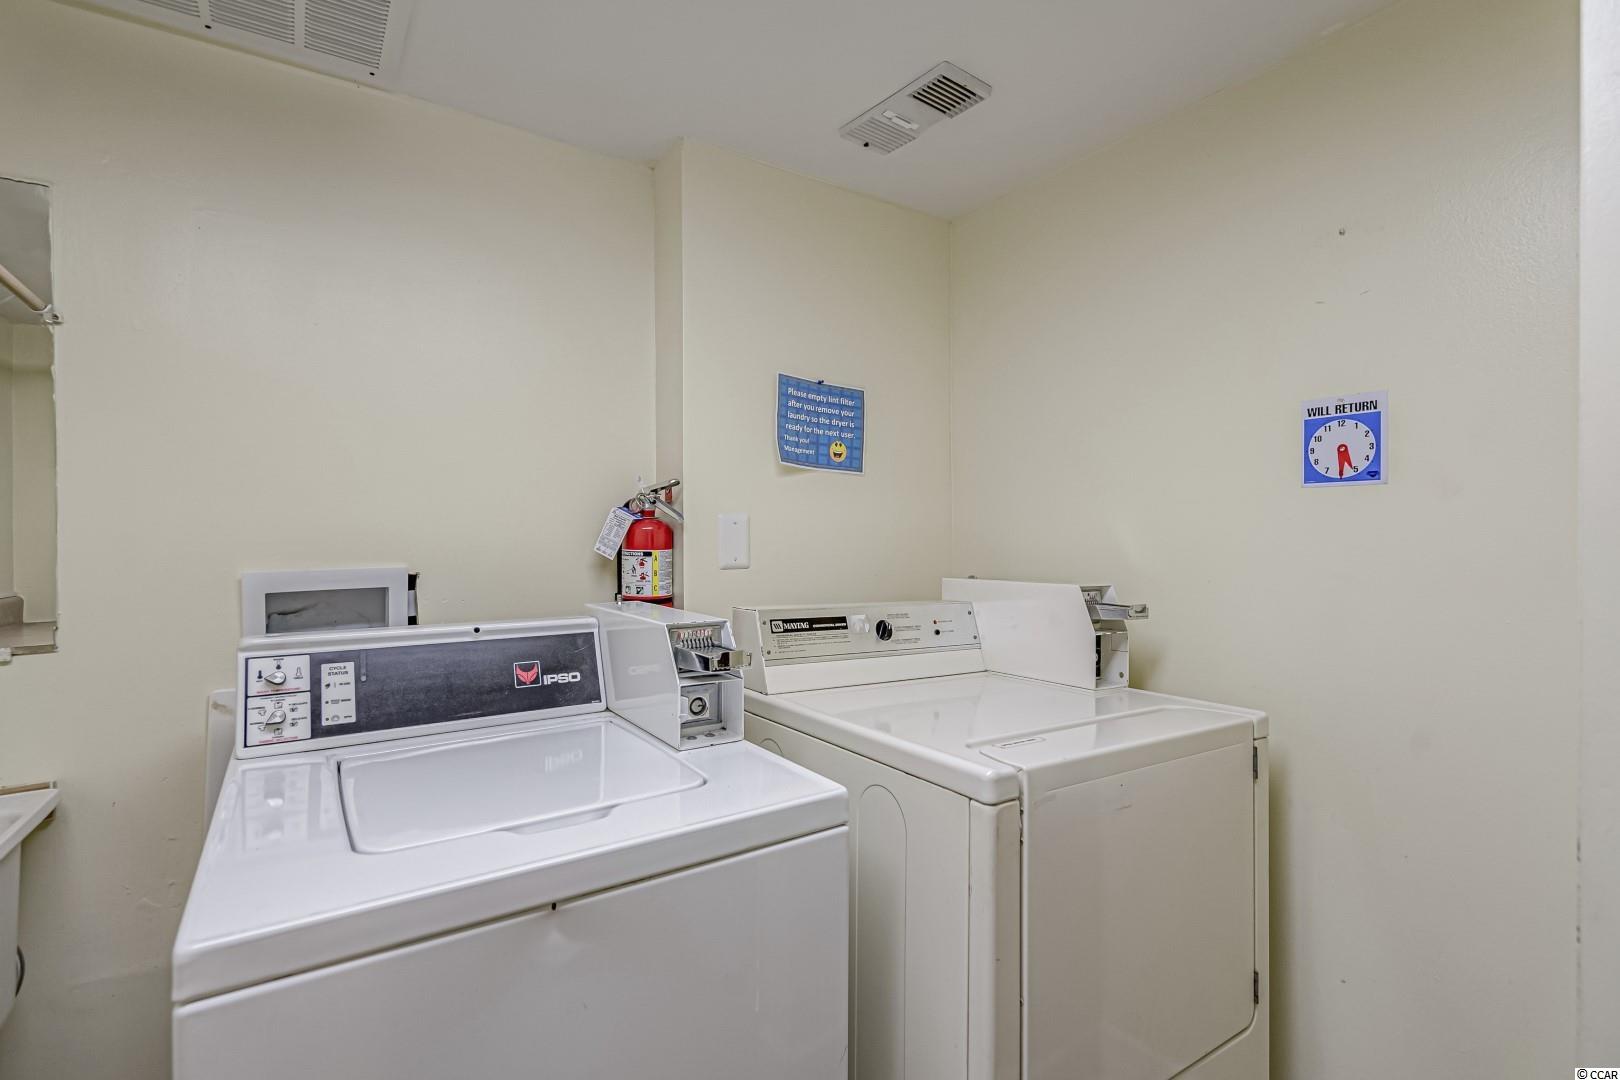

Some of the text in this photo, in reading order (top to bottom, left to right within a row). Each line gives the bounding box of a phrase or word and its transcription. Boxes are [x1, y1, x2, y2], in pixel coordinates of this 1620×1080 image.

[788, 387, 855, 407] Please empty lint filter
[788, 399, 855, 417] after you remove your
[1307, 399, 1378, 418] WILL RETURN
[788, 411, 810, 423] laundry
[819, 417, 830, 425] the
[831, 419, 848, 428] dryer
[849, 420, 855, 428] is
[1337, 419, 1346, 428] 12
[786, 423, 856, 440] ready for the next user.
[1364, 430, 1370, 438] 2
[783, 434, 798, 442] Thank
[1313, 435, 1322, 443] 10
[783, 444, 815, 455] Management
[1369, 442, 1375, 450] 3
[1309, 447, 1315, 455] 9
[1313, 458, 1319, 466] 8
[1364, 454, 1370, 462] 4
[1324, 467, 1330, 475] 7
[1353, 465, 1359, 473] 5
[653, 569, 658, 577] B
[653, 584, 658, 592] C
[783, 621, 810, 630] MAYTAG
[543, 671, 581, 685] IPSO
